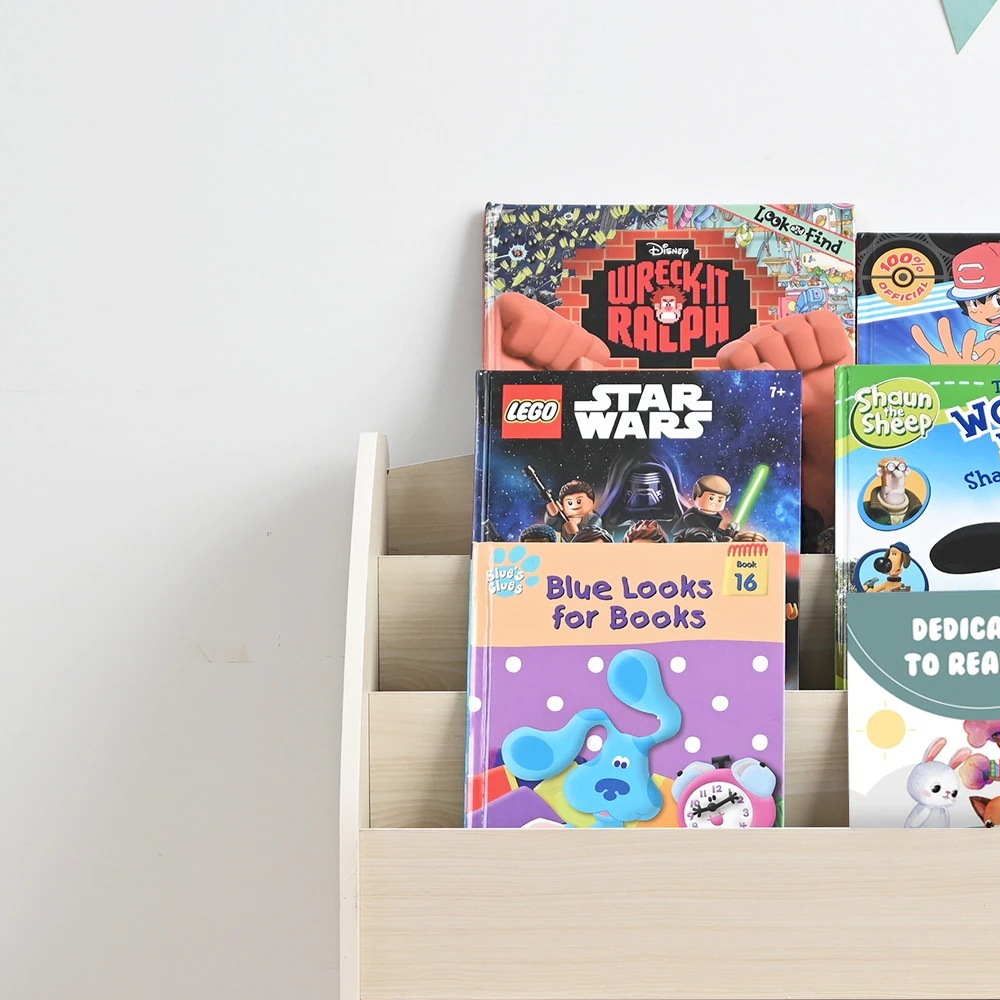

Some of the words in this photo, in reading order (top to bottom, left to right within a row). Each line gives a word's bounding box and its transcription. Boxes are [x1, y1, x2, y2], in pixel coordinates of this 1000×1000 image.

[754, 205, 791, 232] Look
[791, 225, 805, 235] and
[806, 228, 843, 255] Find
[880, 253, 926, 272] 100%
[608, 260, 729, 304] WRECK-IT
[878, 282, 928, 301] OFFICIAL
[608, 306, 729, 352] RALPH
[574, 384, 712, 412] STAR
[769, 386, 786, 398] 7+
[855, 386, 932, 413] Shaun
[505, 400, 558, 422] LEGO
[884, 406, 905, 418] the
[574, 412, 712, 440] WARS
[862, 413, 934, 437] Sheep
[488, 566, 524, 582] Blue's
[734, 573, 758, 592] 16
[488, 581, 524, 594] Clues
[546, 575, 613, 600] Blue
[622, 576, 713, 600] Looks
[552, 604, 598, 630] for
[610, 606, 706, 630] Books
[904, 652, 940, 677] TO
[712, 785, 722, 794] 12
[690, 800, 700, 808] 10
[743, 809, 750, 817] 3
